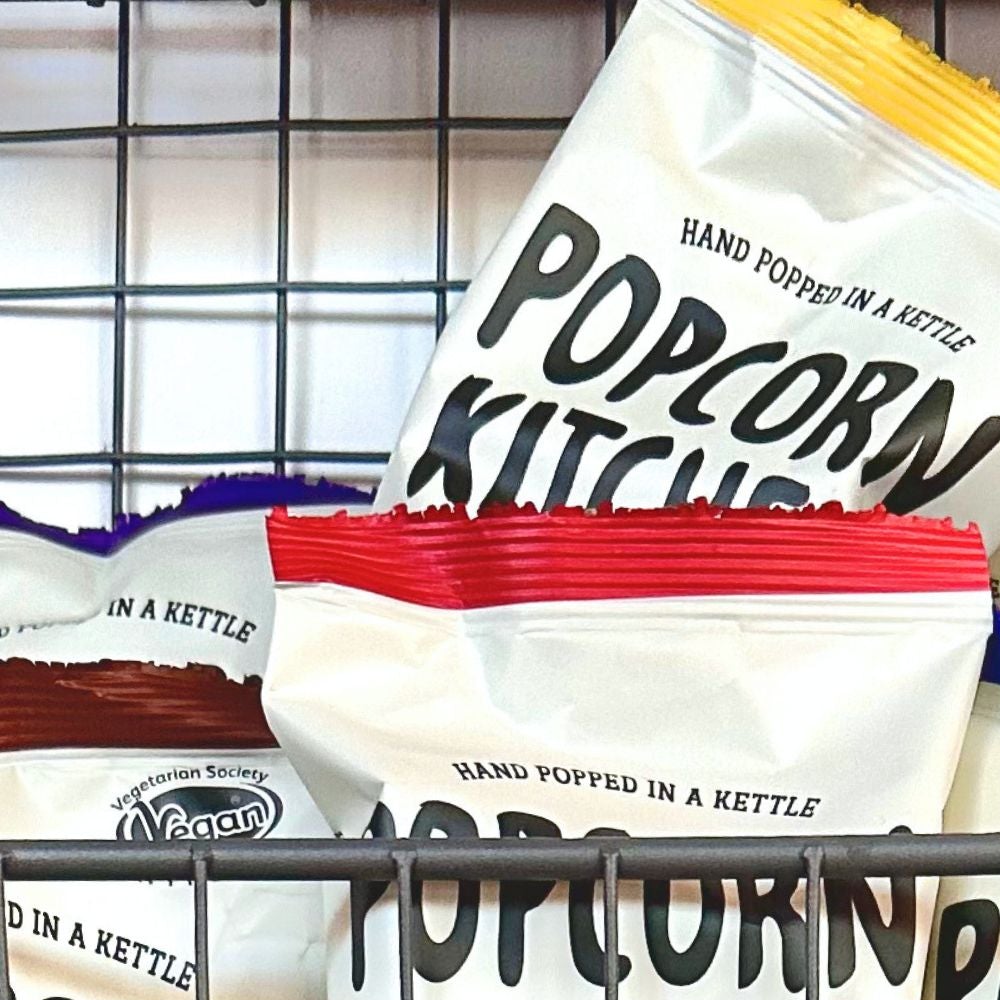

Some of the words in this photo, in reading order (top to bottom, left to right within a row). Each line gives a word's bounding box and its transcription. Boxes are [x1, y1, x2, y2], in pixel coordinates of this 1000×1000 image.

[680, 217, 751, 263] HAND
[752, 246, 844, 305] POPPED
[841, 286, 876, 313] IN
[871, 297, 896, 320] A
[892, 304, 977, 354] KETTLE
[106, 597, 136, 619] IN
[139, 598, 156, 620] A
[164, 600, 257, 644] KETTLE
[110, 767, 201, 812] Vegetarian
[206, 764, 270, 784] Society
[452, 761, 529, 782] HAND
[535, 764, 639, 794] POPPED
[647, 779, 676, 804] IN
[685, 787, 704, 808] A
[713, 789, 822, 819] KETTLE
[32, 907, 60, 941] IN
[68, 921, 86, 950] A
[94, 928, 197, 992] KETTLE
